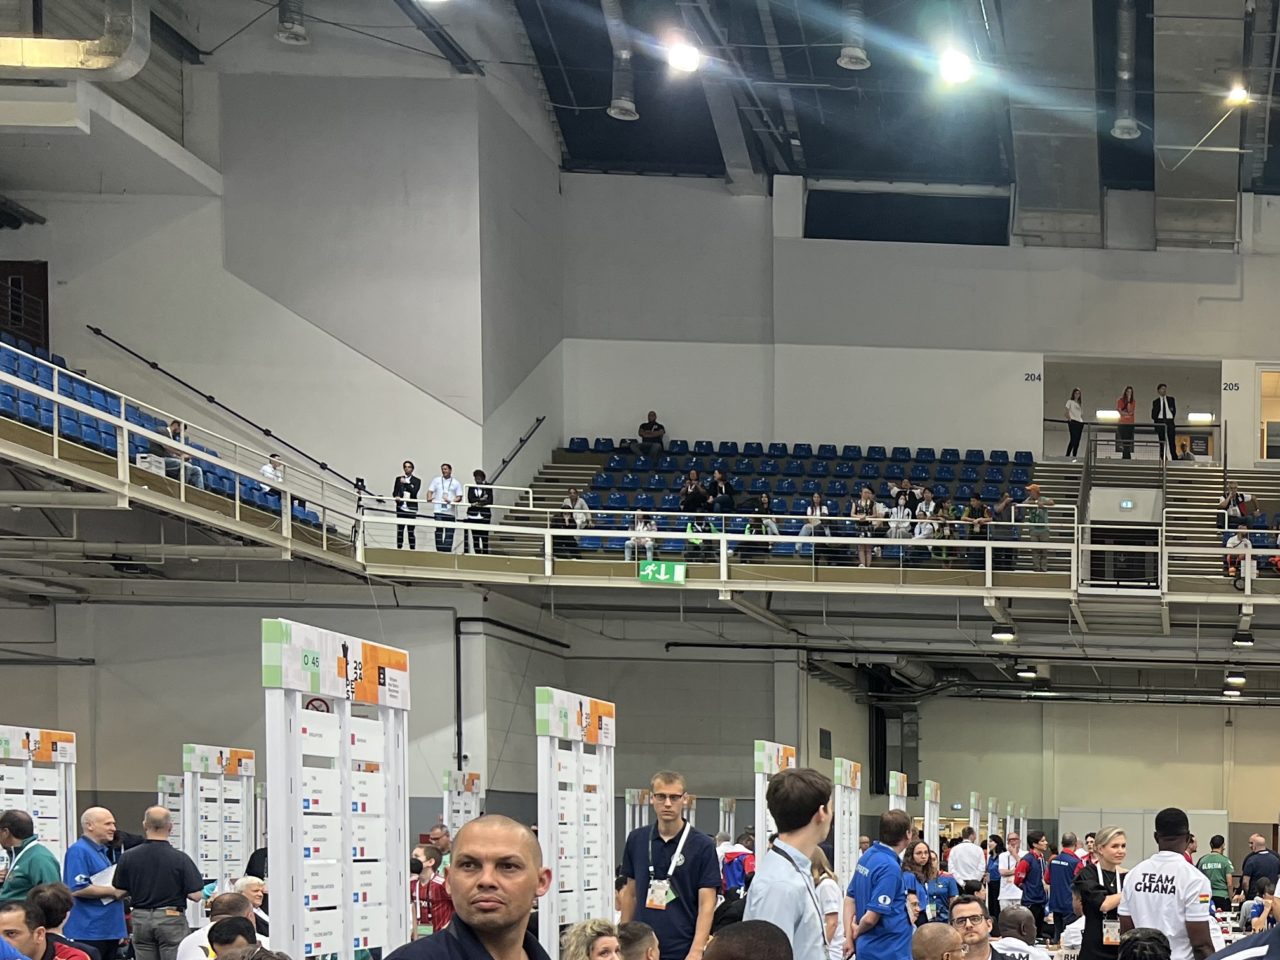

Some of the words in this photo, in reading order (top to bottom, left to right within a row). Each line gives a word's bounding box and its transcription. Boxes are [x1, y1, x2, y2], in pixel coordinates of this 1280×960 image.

[1024, 373, 1042, 382] 204
[1222, 383, 1240, 391] 205
[311, 657, 320, 668] 45
[353, 660, 362, 671] 20
[353, 671, 363, 681] 24
[1141, 872, 1176, 885] TEAM
[1134, 882, 1176, 895] GHANA
